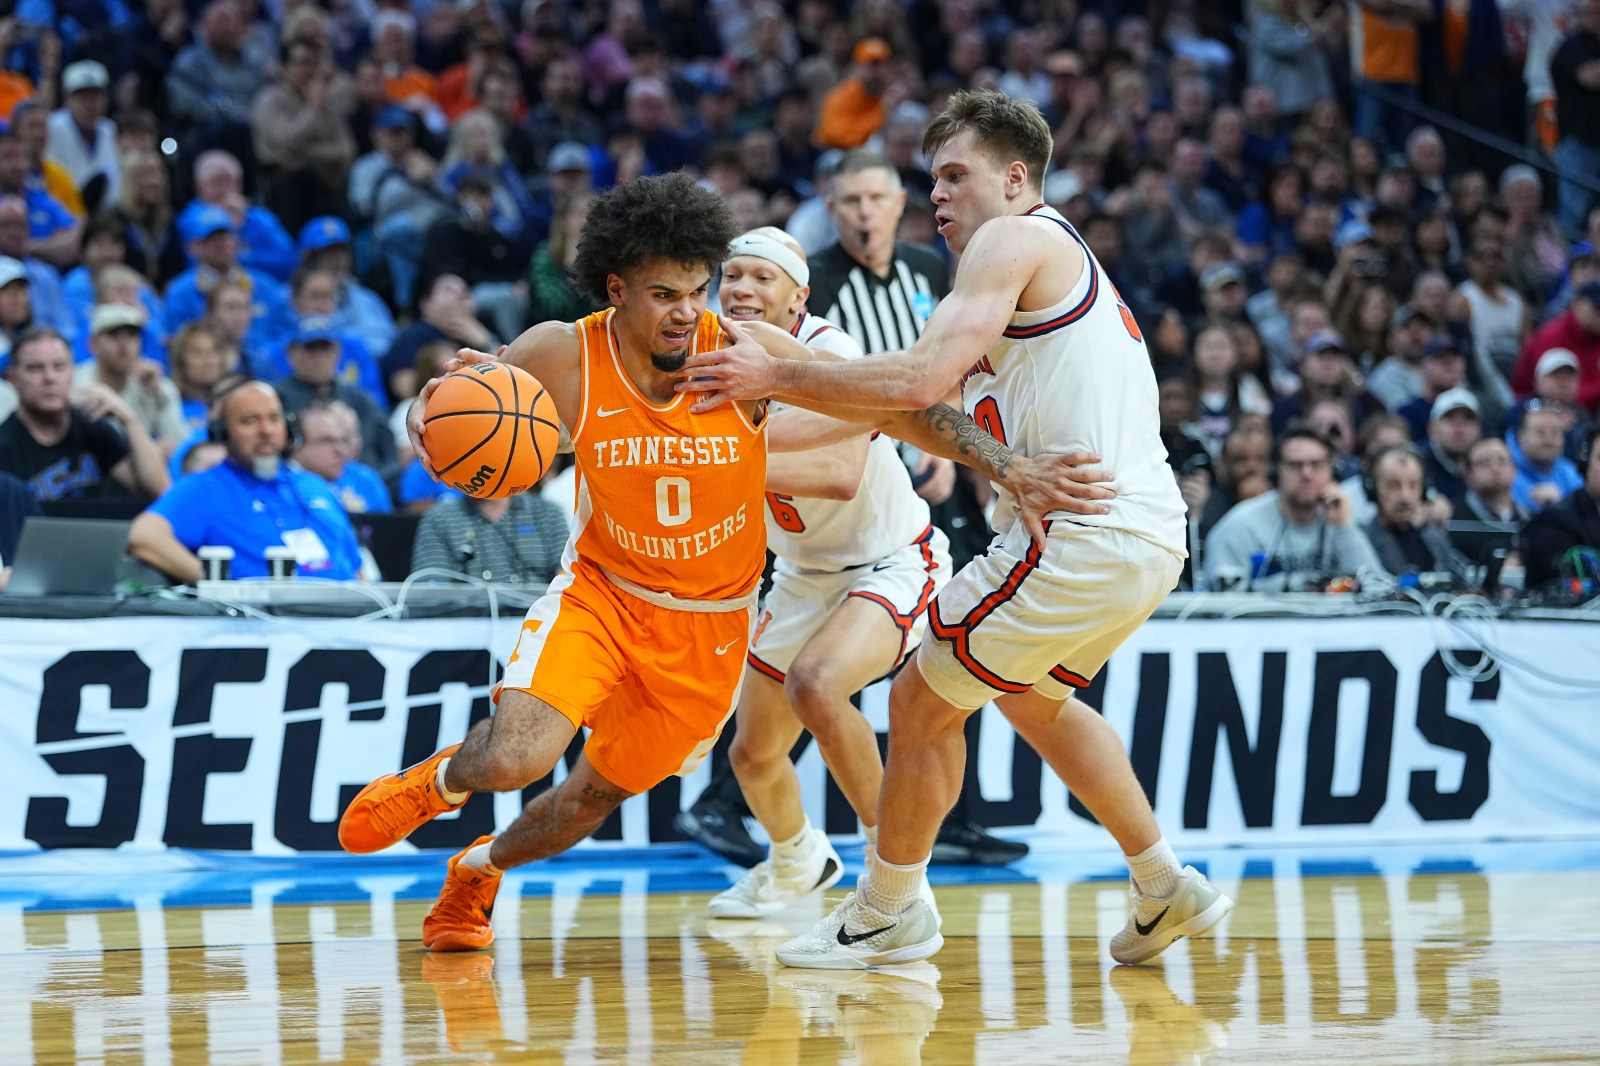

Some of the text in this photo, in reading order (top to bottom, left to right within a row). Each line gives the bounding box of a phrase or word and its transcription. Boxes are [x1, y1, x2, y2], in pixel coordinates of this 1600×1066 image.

[594, 436, 740, 468] TENNESSEE
[453, 464, 497, 495] lson
[655, 476, 692, 527] 0
[604, 503, 747, 560] VOLUNTEERS
